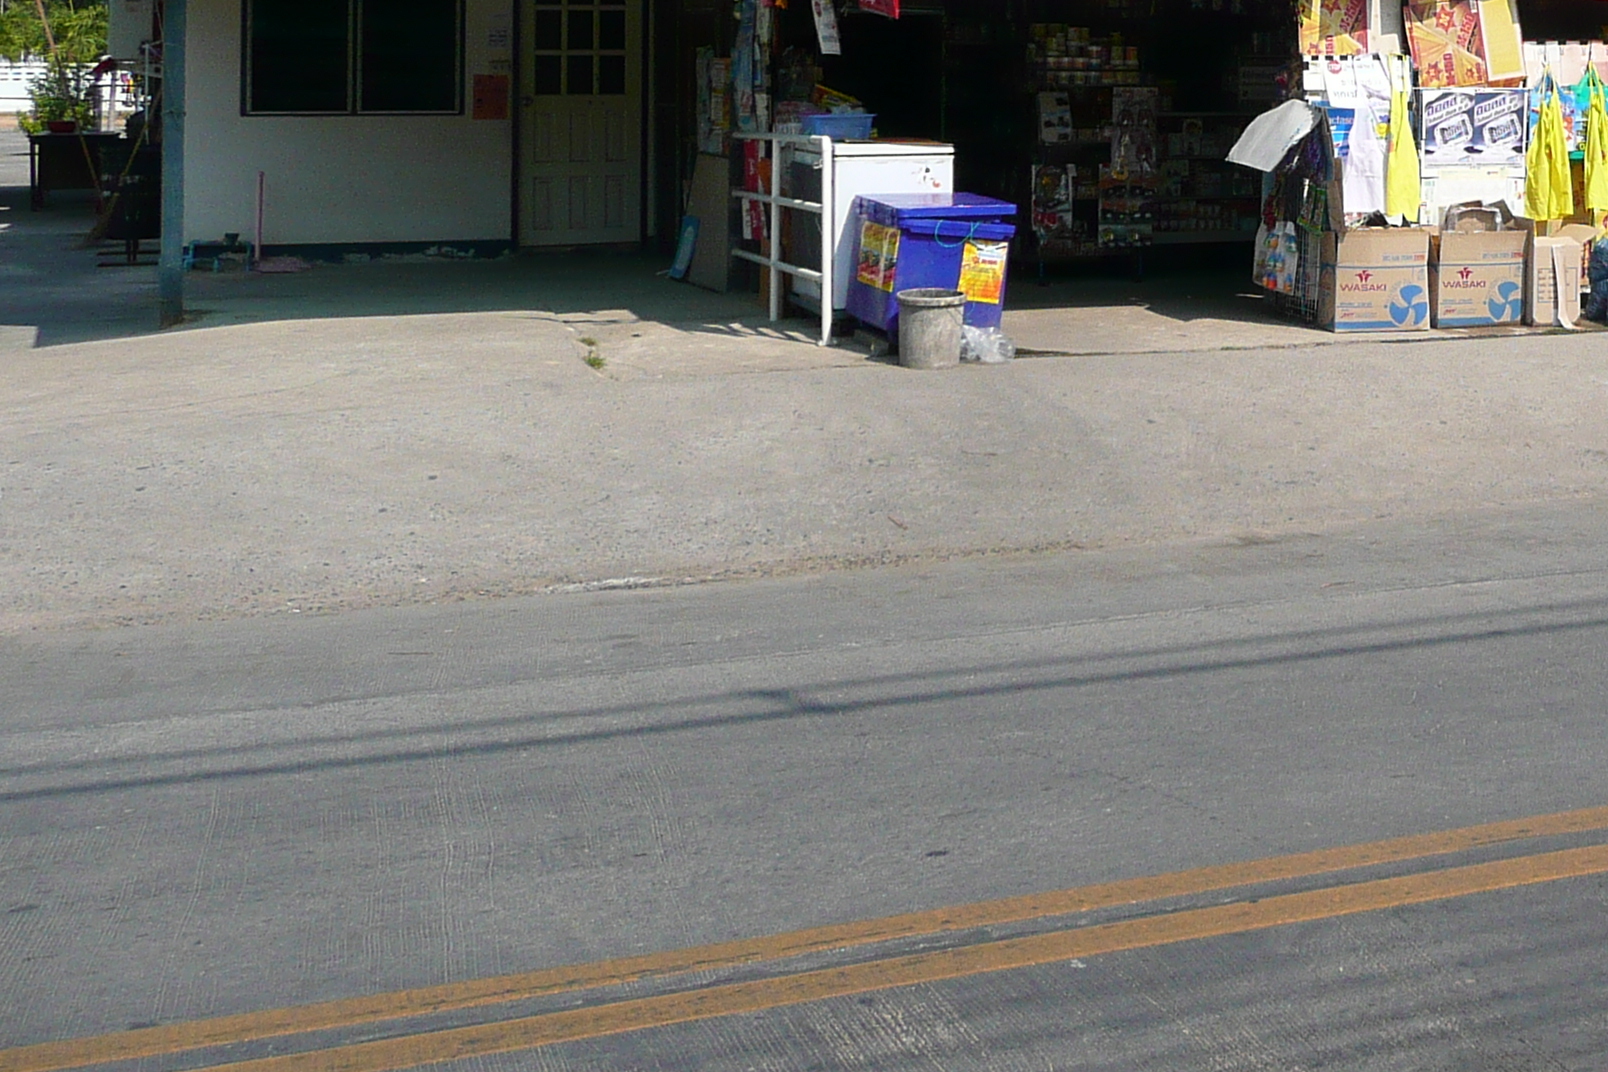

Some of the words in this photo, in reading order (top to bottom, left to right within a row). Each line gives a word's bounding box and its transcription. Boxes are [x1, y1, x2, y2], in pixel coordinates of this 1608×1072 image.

[1456, 12, 1475, 49] M-150
[1340, 283, 1387, 292] WASAKI
[1442, 279, 1486, 289] WASAKI
